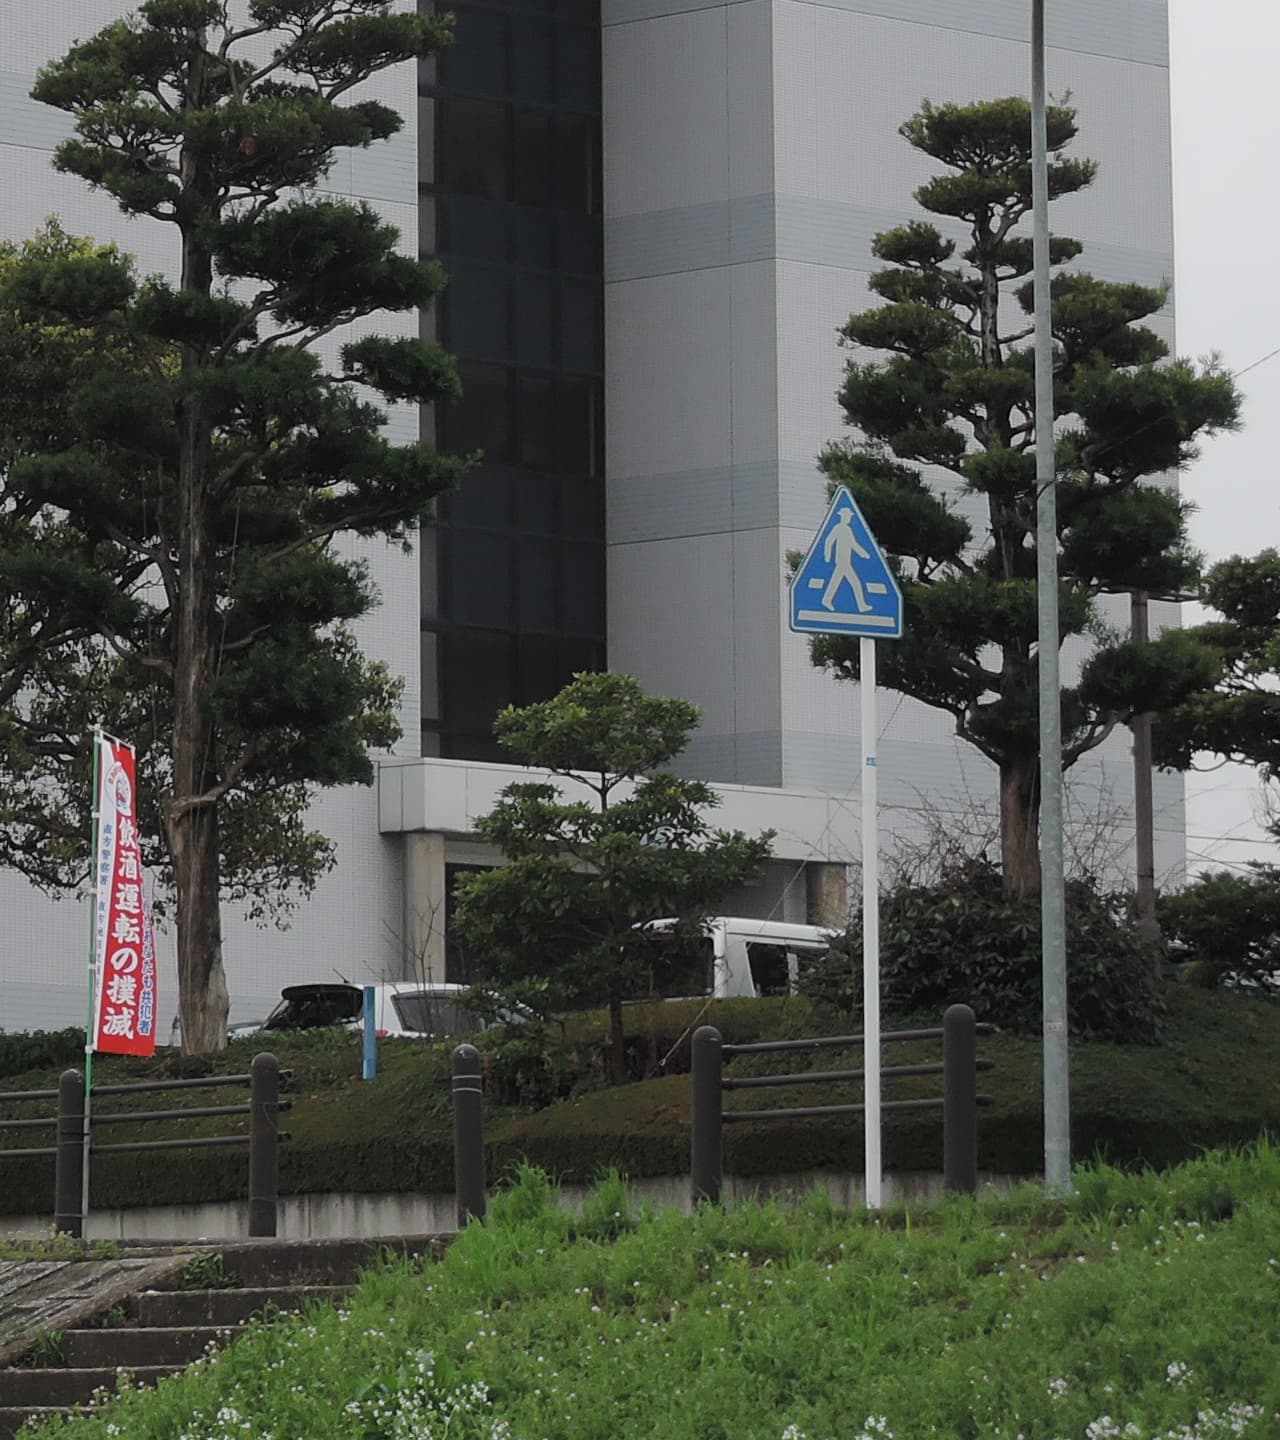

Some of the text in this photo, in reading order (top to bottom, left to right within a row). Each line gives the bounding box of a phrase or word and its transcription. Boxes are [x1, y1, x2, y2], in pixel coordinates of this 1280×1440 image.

[103, 817, 141, 1039] 飲酒運転の撲滅
